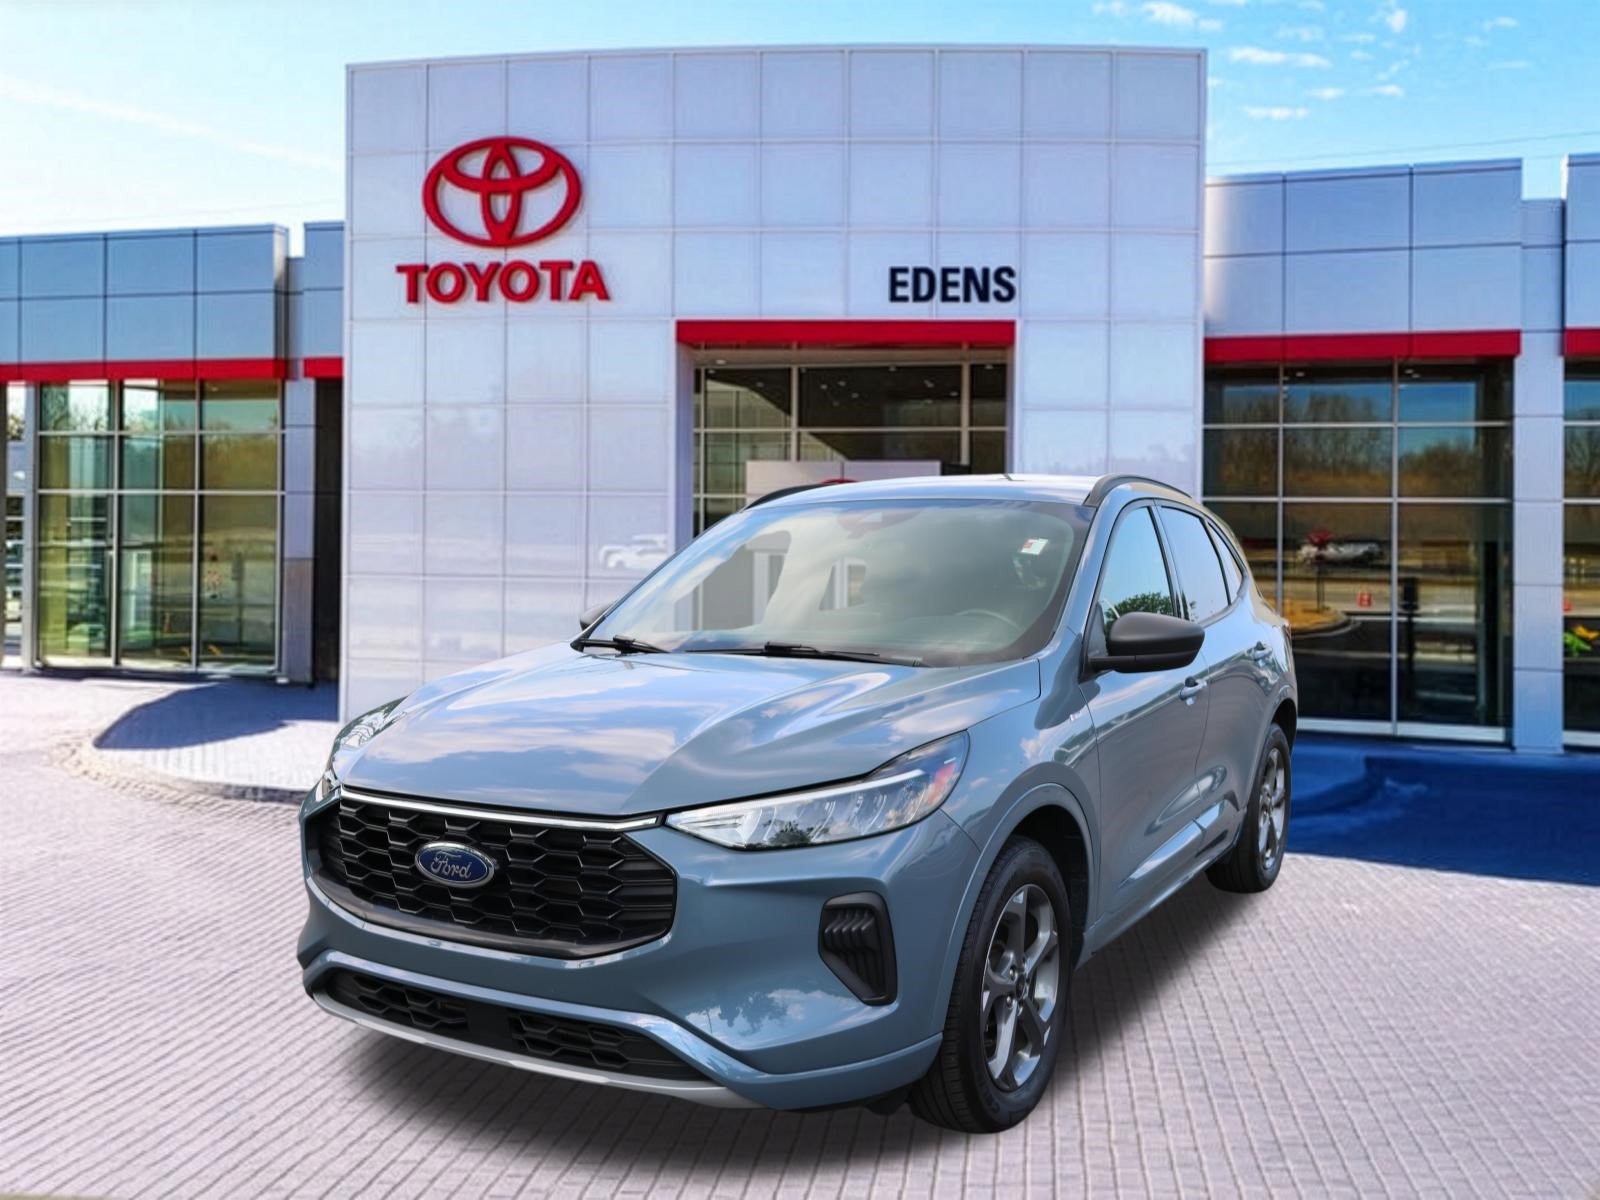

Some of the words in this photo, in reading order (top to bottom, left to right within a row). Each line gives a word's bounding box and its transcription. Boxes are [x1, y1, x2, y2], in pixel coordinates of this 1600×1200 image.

[396, 260, 611, 304] TOYOTA
[889, 266, 1017, 303] EDENS
[430, 850, 473, 879] Ford
